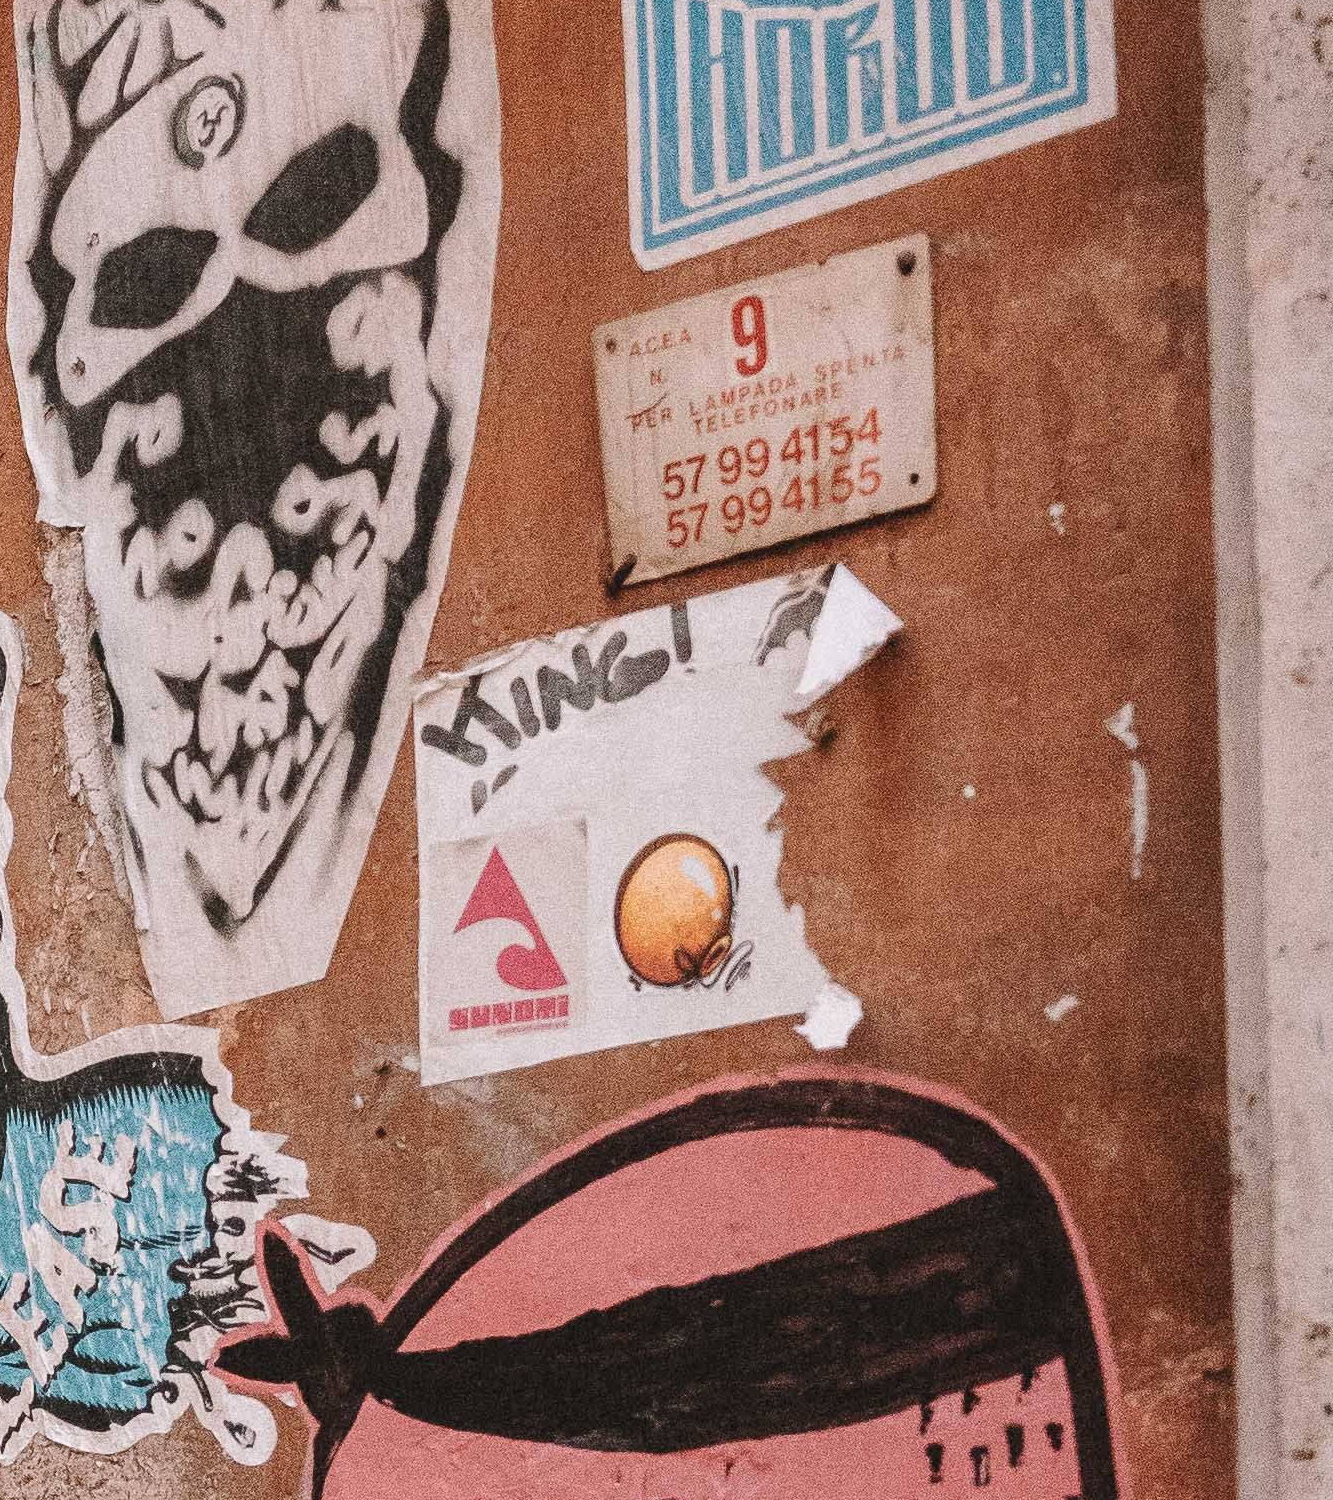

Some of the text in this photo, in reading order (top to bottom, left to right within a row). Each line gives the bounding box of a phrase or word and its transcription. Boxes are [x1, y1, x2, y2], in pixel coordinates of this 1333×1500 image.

[731, 296, 768, 377] 9
[688, 373, 798, 421] LAMPADA
[693, 382, 844, 436] TELEFONARE
[662, 406, 882, 501] 57 99 4154
[667, 456, 882, 549] 57 99 4155
